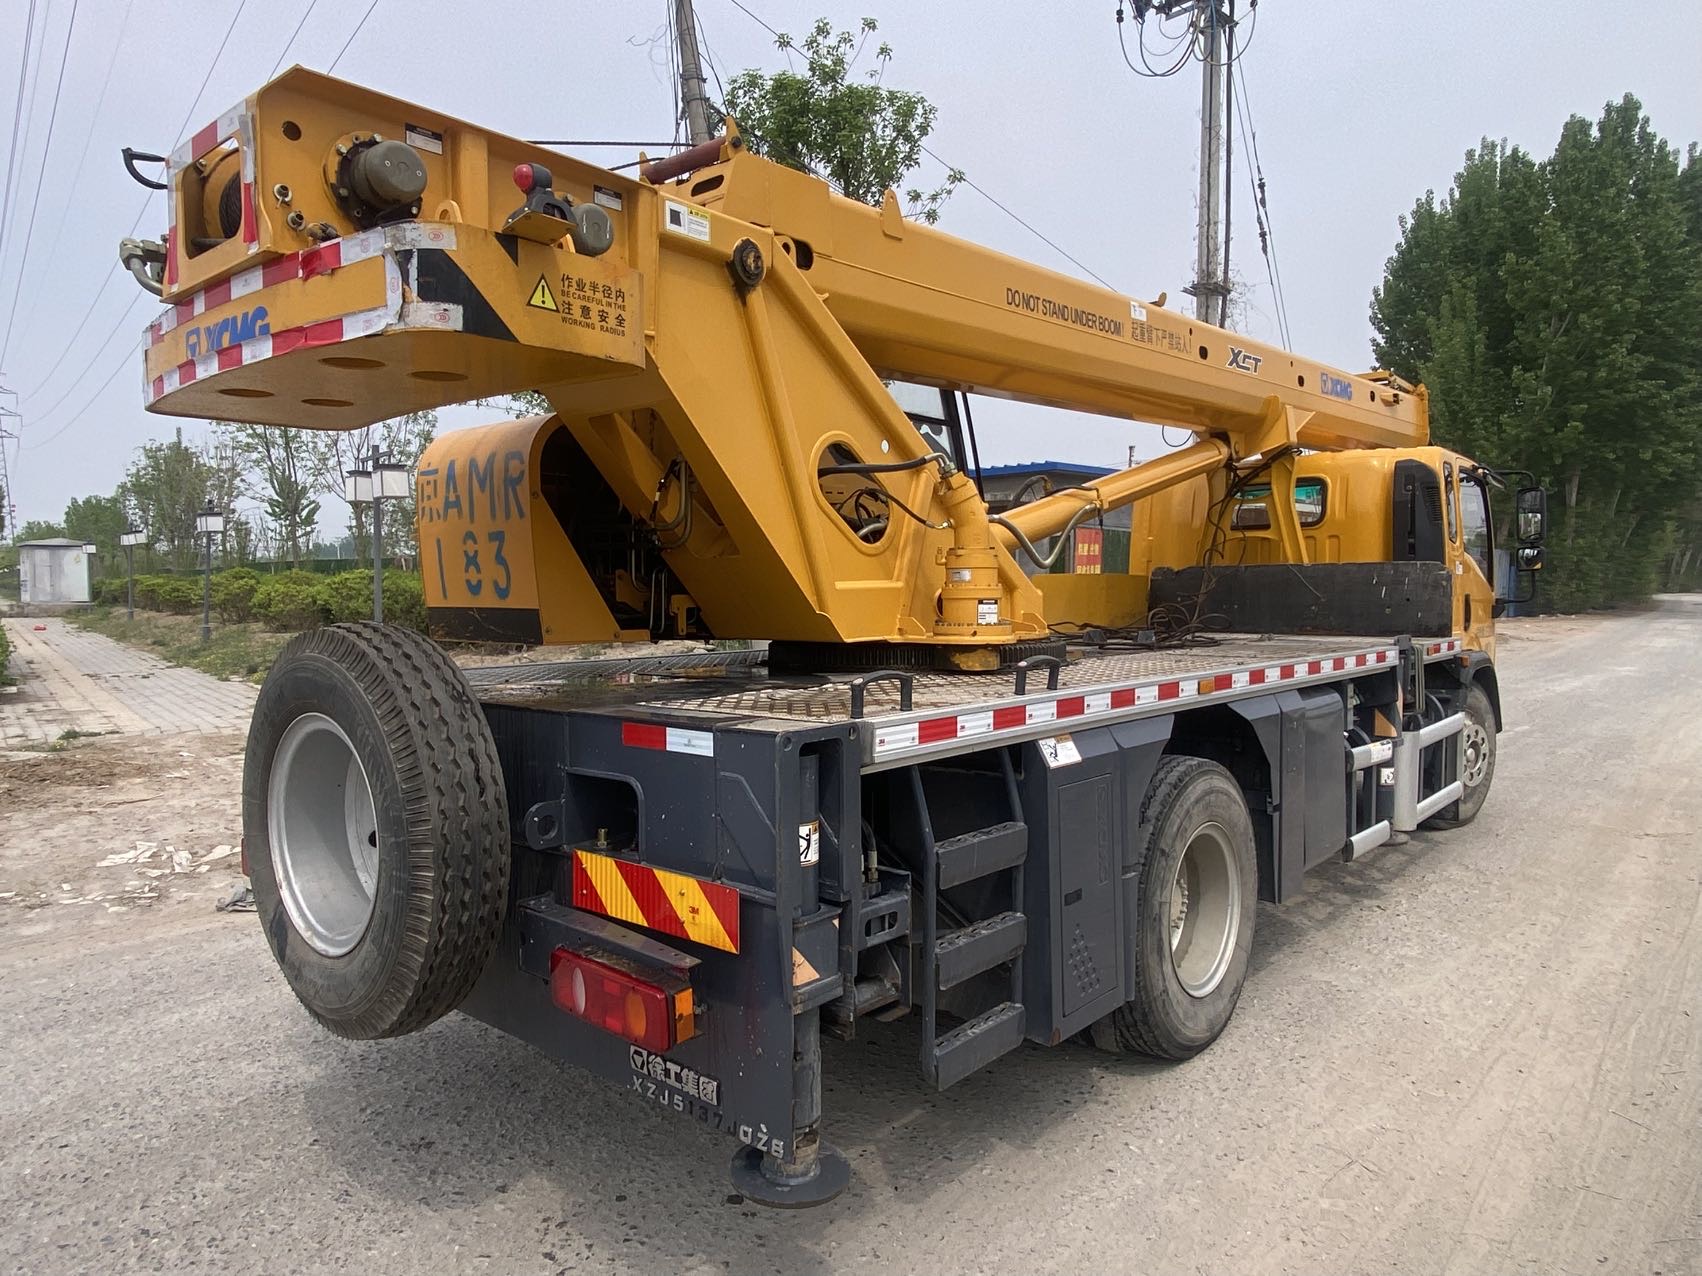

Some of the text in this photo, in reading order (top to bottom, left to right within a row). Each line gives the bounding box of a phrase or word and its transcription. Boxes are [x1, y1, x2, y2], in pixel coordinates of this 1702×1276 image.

[561, 273, 625, 303] 作业半径内
[561, 289, 626, 312] BE CAREFUL IN THE
[561, 300, 626, 328] 注意安全
[1006, 287, 1021, 308] DO
[1022, 292, 1041, 313] NOT
[1041, 298, 1069, 322] STAND
[1070, 306, 1097, 330] UNDER
[204, 306, 271, 351] XCMG
[561, 316, 626, 337] WORKING RADIUS
[1227, 346, 1262, 375] XCT
[436, 529, 511, 600] 183
[648, 1054, 719, 1106] 徐工集团
